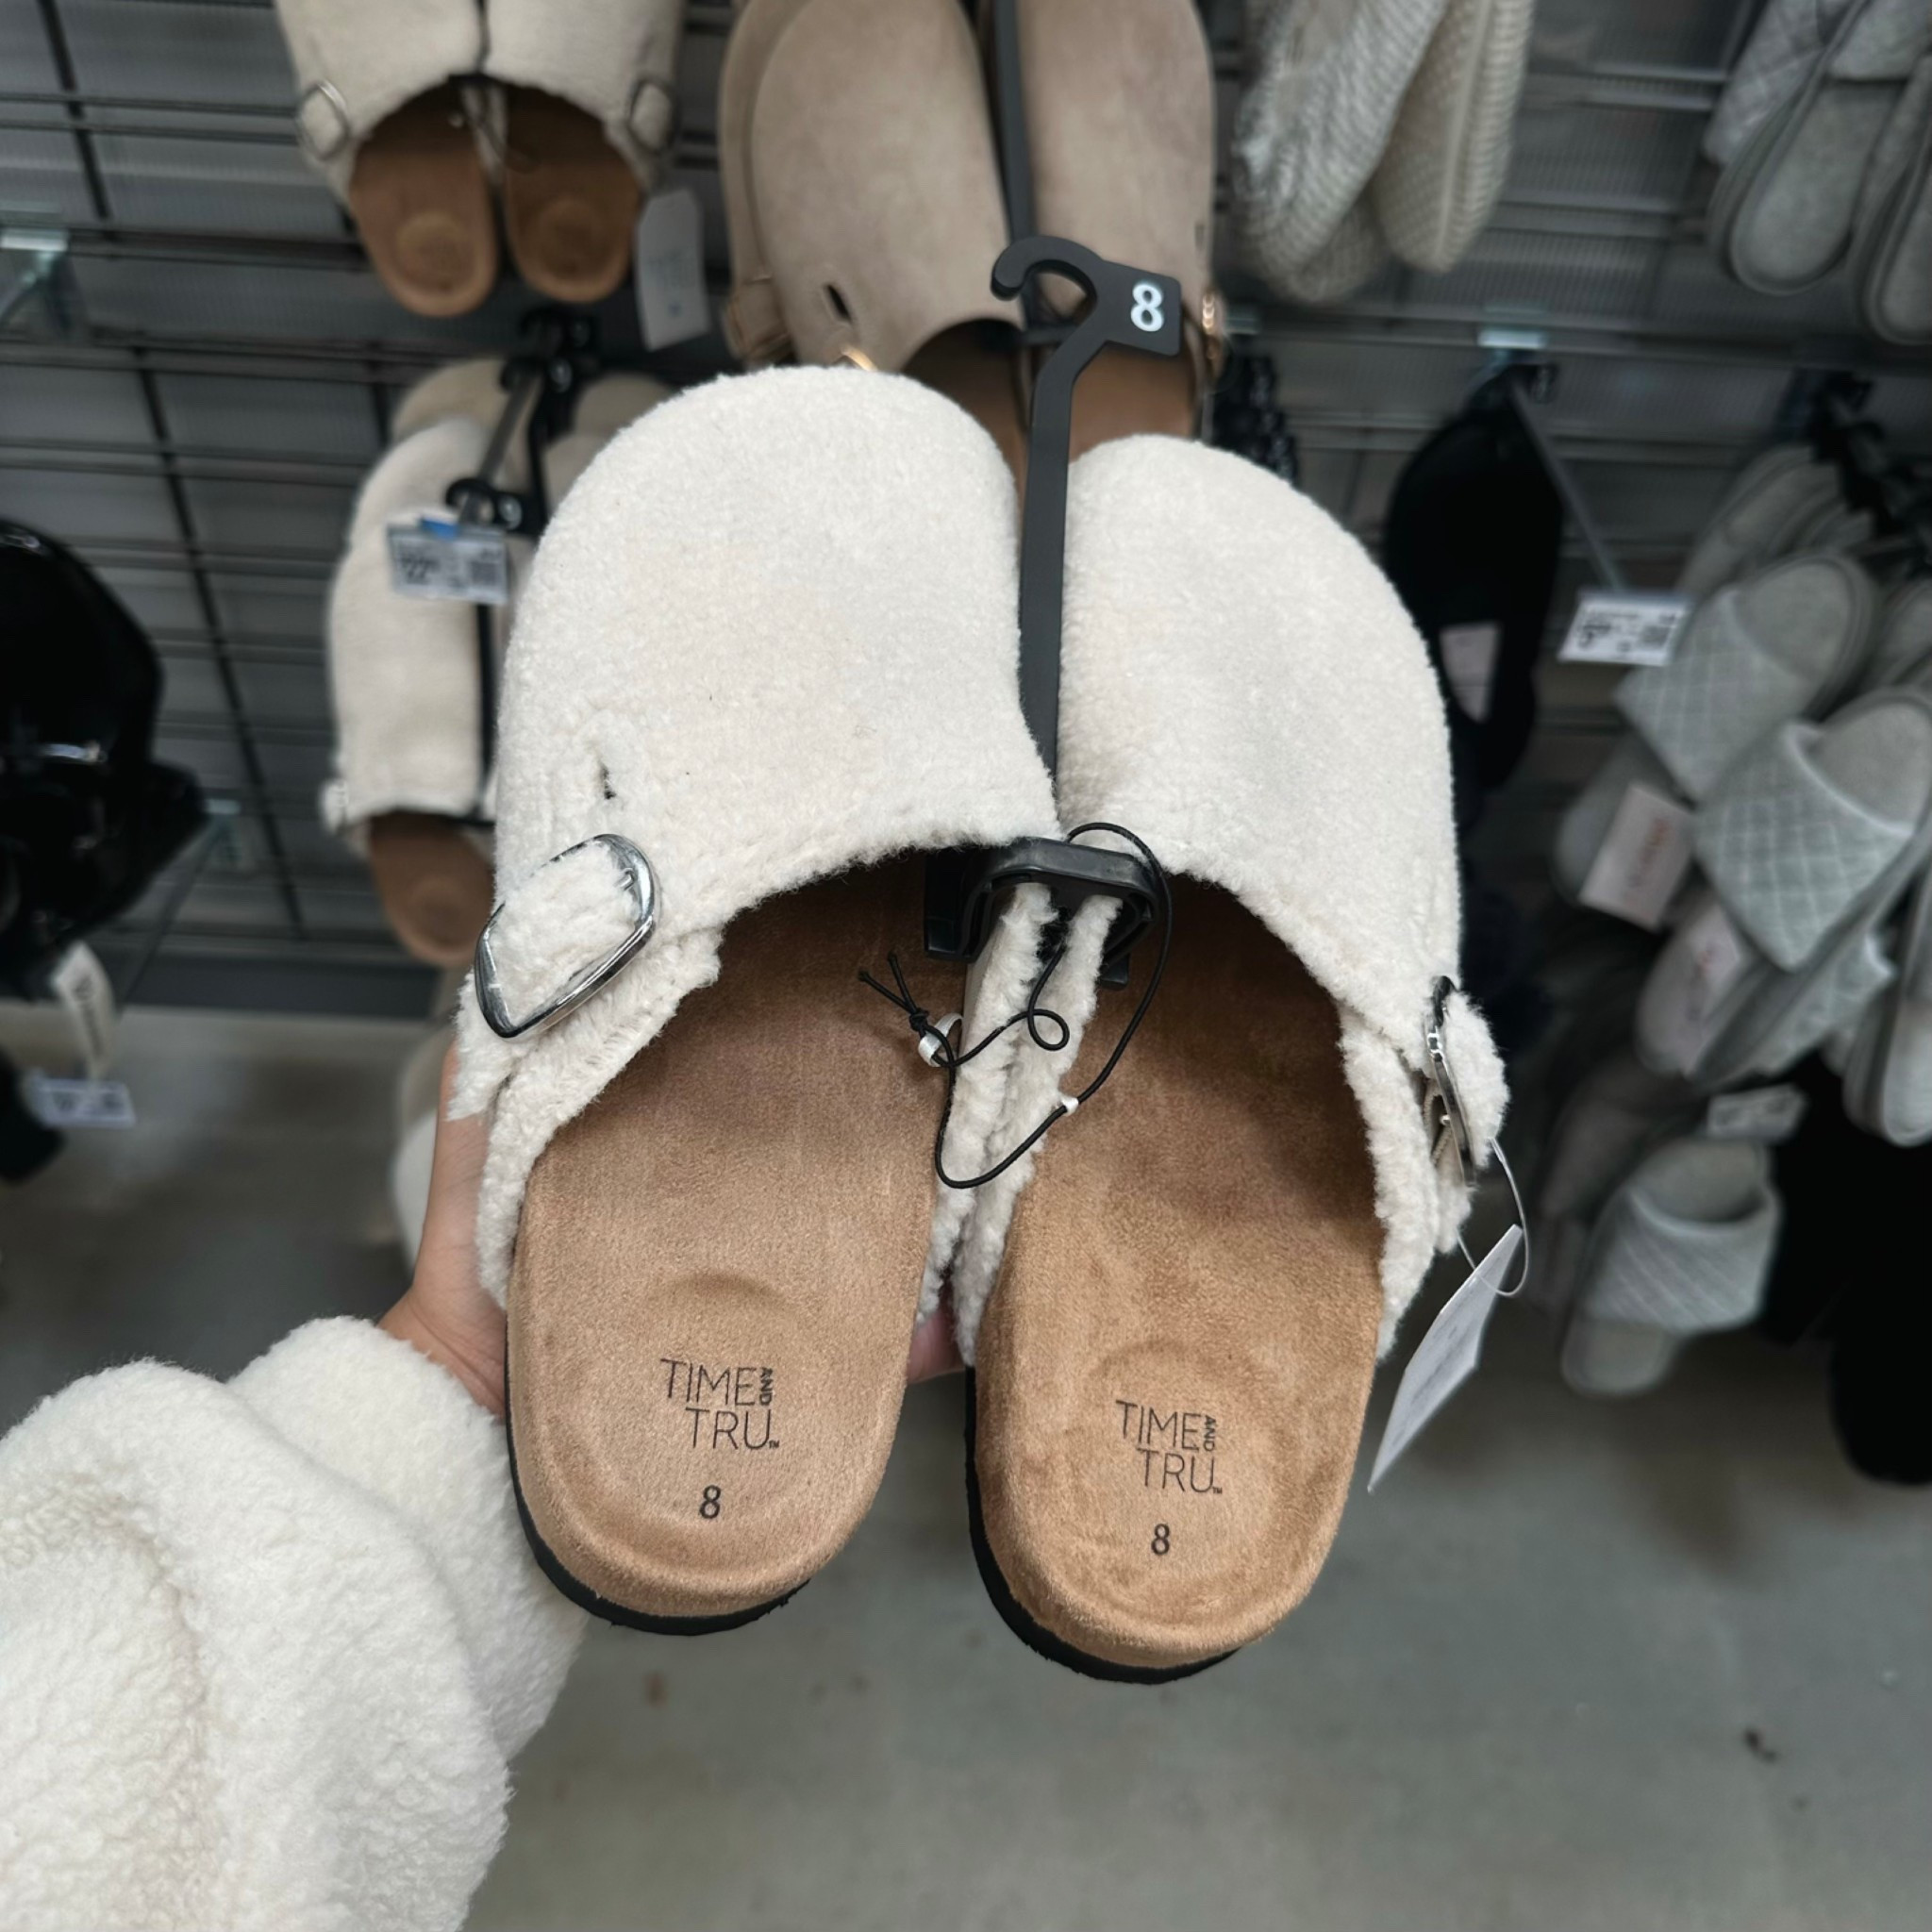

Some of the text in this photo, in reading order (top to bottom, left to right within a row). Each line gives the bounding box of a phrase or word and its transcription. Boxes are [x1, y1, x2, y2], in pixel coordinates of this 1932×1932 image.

[1130, 283, 1164, 332] 8
[660, 1357, 774, 1406] TIME AND
[1115, 1399, 1217, 1453] TIME AND
[699, 1484, 722, 1520] 8
[1150, 1523, 1171, 1557] 8
